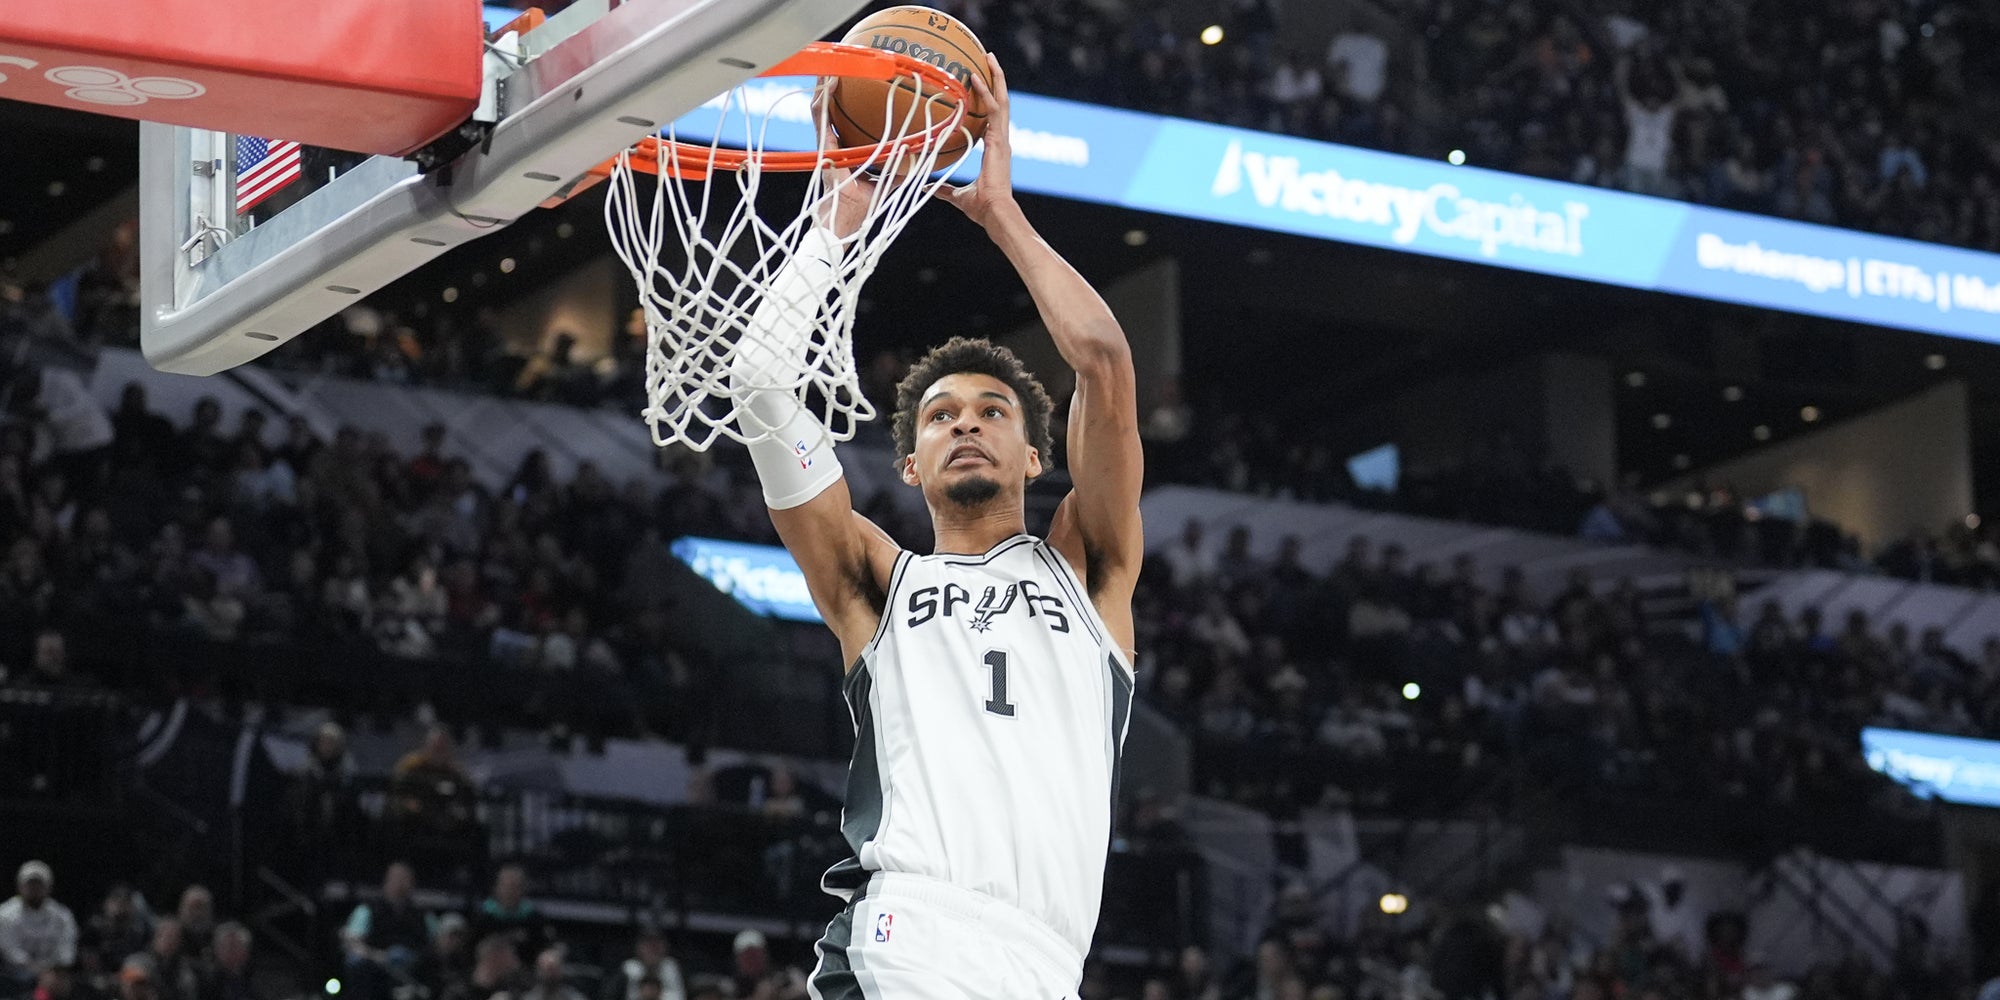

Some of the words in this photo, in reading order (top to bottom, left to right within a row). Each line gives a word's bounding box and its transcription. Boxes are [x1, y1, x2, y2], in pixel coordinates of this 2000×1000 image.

[1697, 233, 1845, 293] Brokerage
[907, 579, 1070, 635] SPURS
[982, 647, 1018, 720] 1
